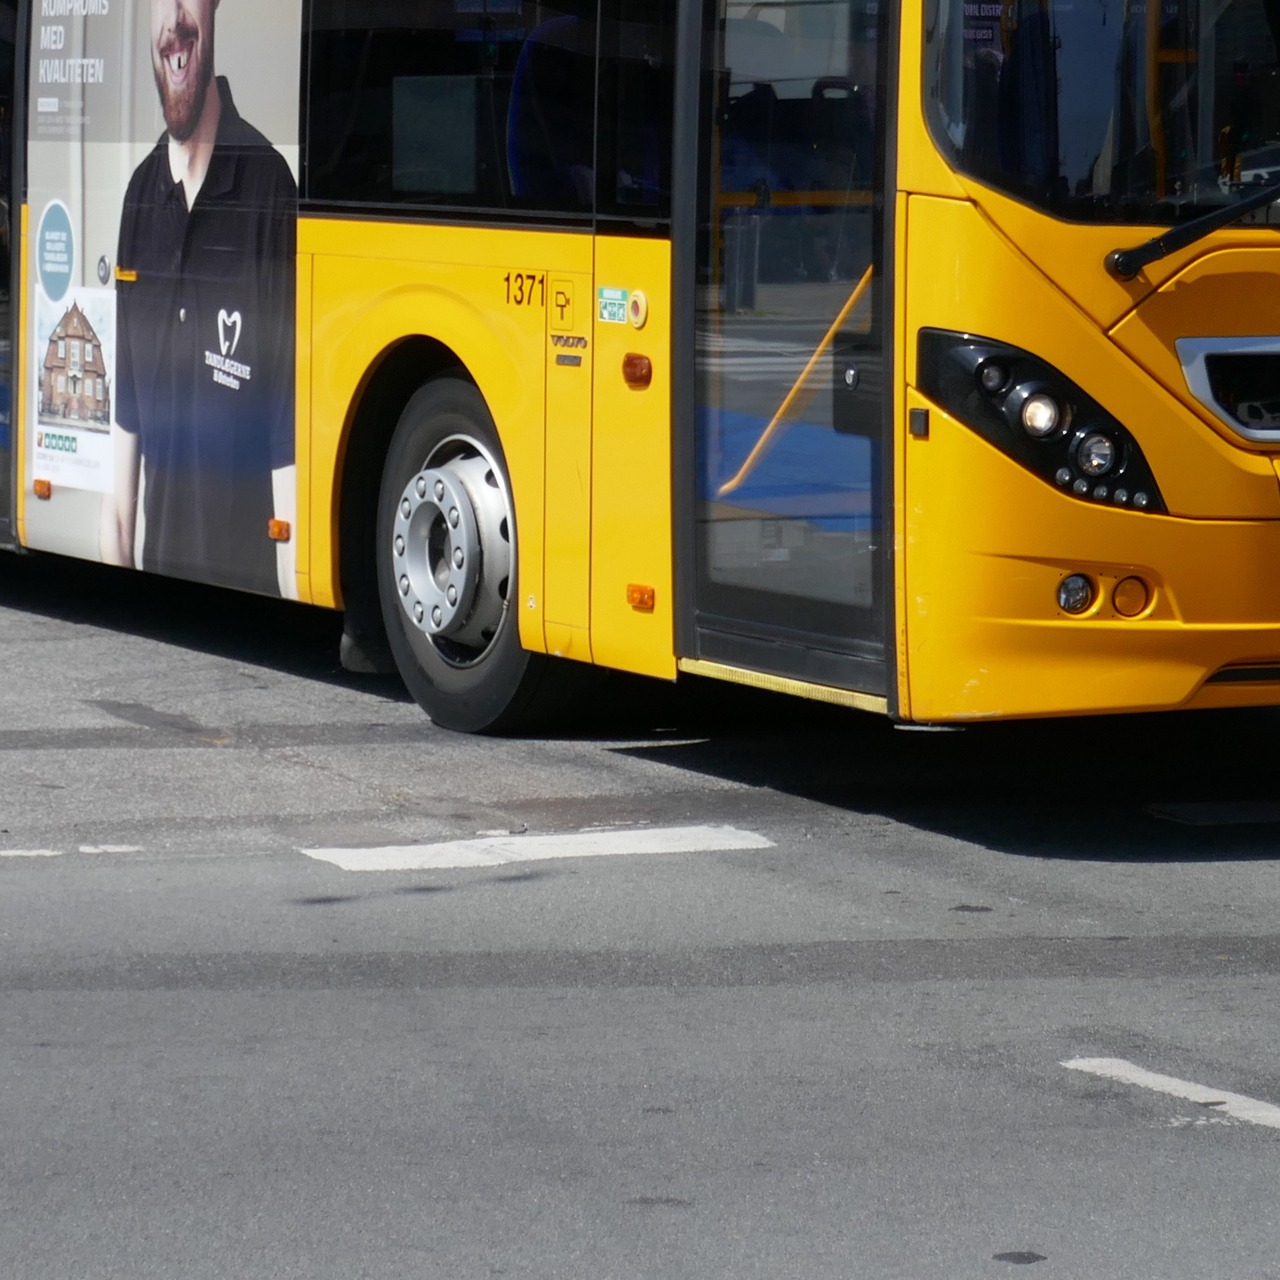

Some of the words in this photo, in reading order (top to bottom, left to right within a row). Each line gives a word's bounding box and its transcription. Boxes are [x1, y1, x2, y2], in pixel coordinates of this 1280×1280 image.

[40, 25, 65, 50] MED
[39, 58, 104, 83] KVALITETEN
[504, 272, 545, 307] 1371
[551, 334, 588, 349] VOLVO
